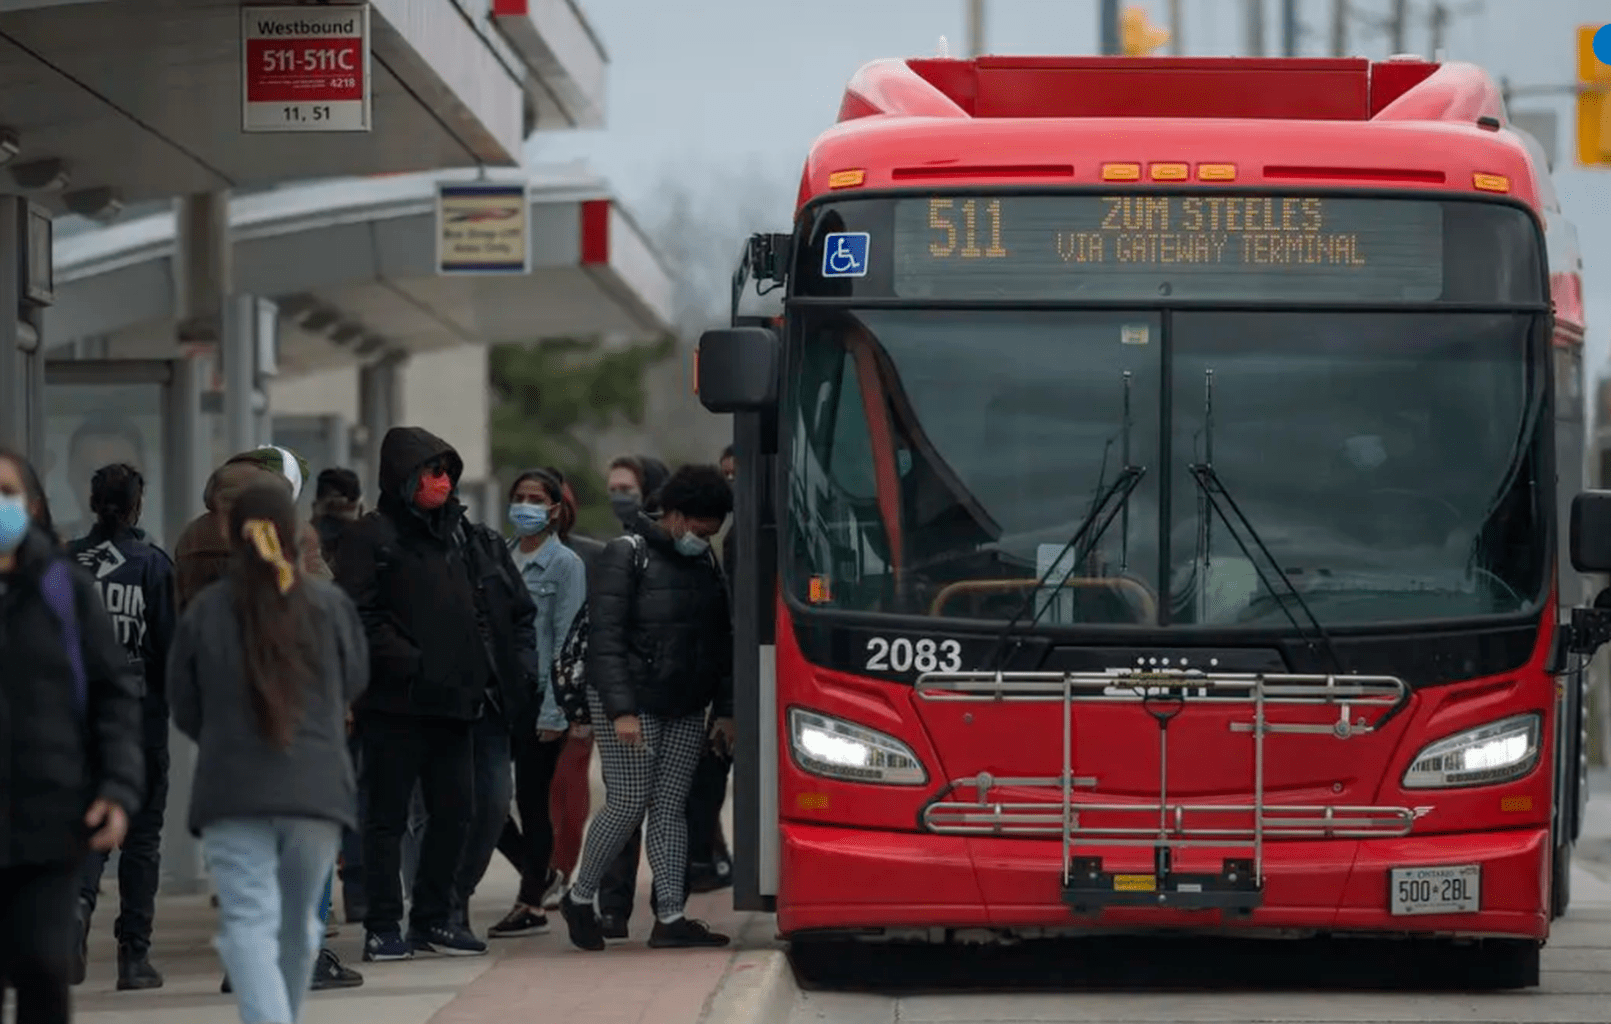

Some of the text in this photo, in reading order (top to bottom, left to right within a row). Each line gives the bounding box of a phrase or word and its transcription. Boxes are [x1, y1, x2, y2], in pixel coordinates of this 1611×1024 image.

[257, 19, 354, 35] Westbound
[263, 48, 354, 71] 511-511C
[313, 106, 330, 120] 51
[930, 199, 1006, 257] 511
[1101, 197, 1322, 230] ZUM STEELES
[1057, 233, 1365, 264] VIA GATEWAY TERMINAL
[865, 637, 962, 672] 2083
